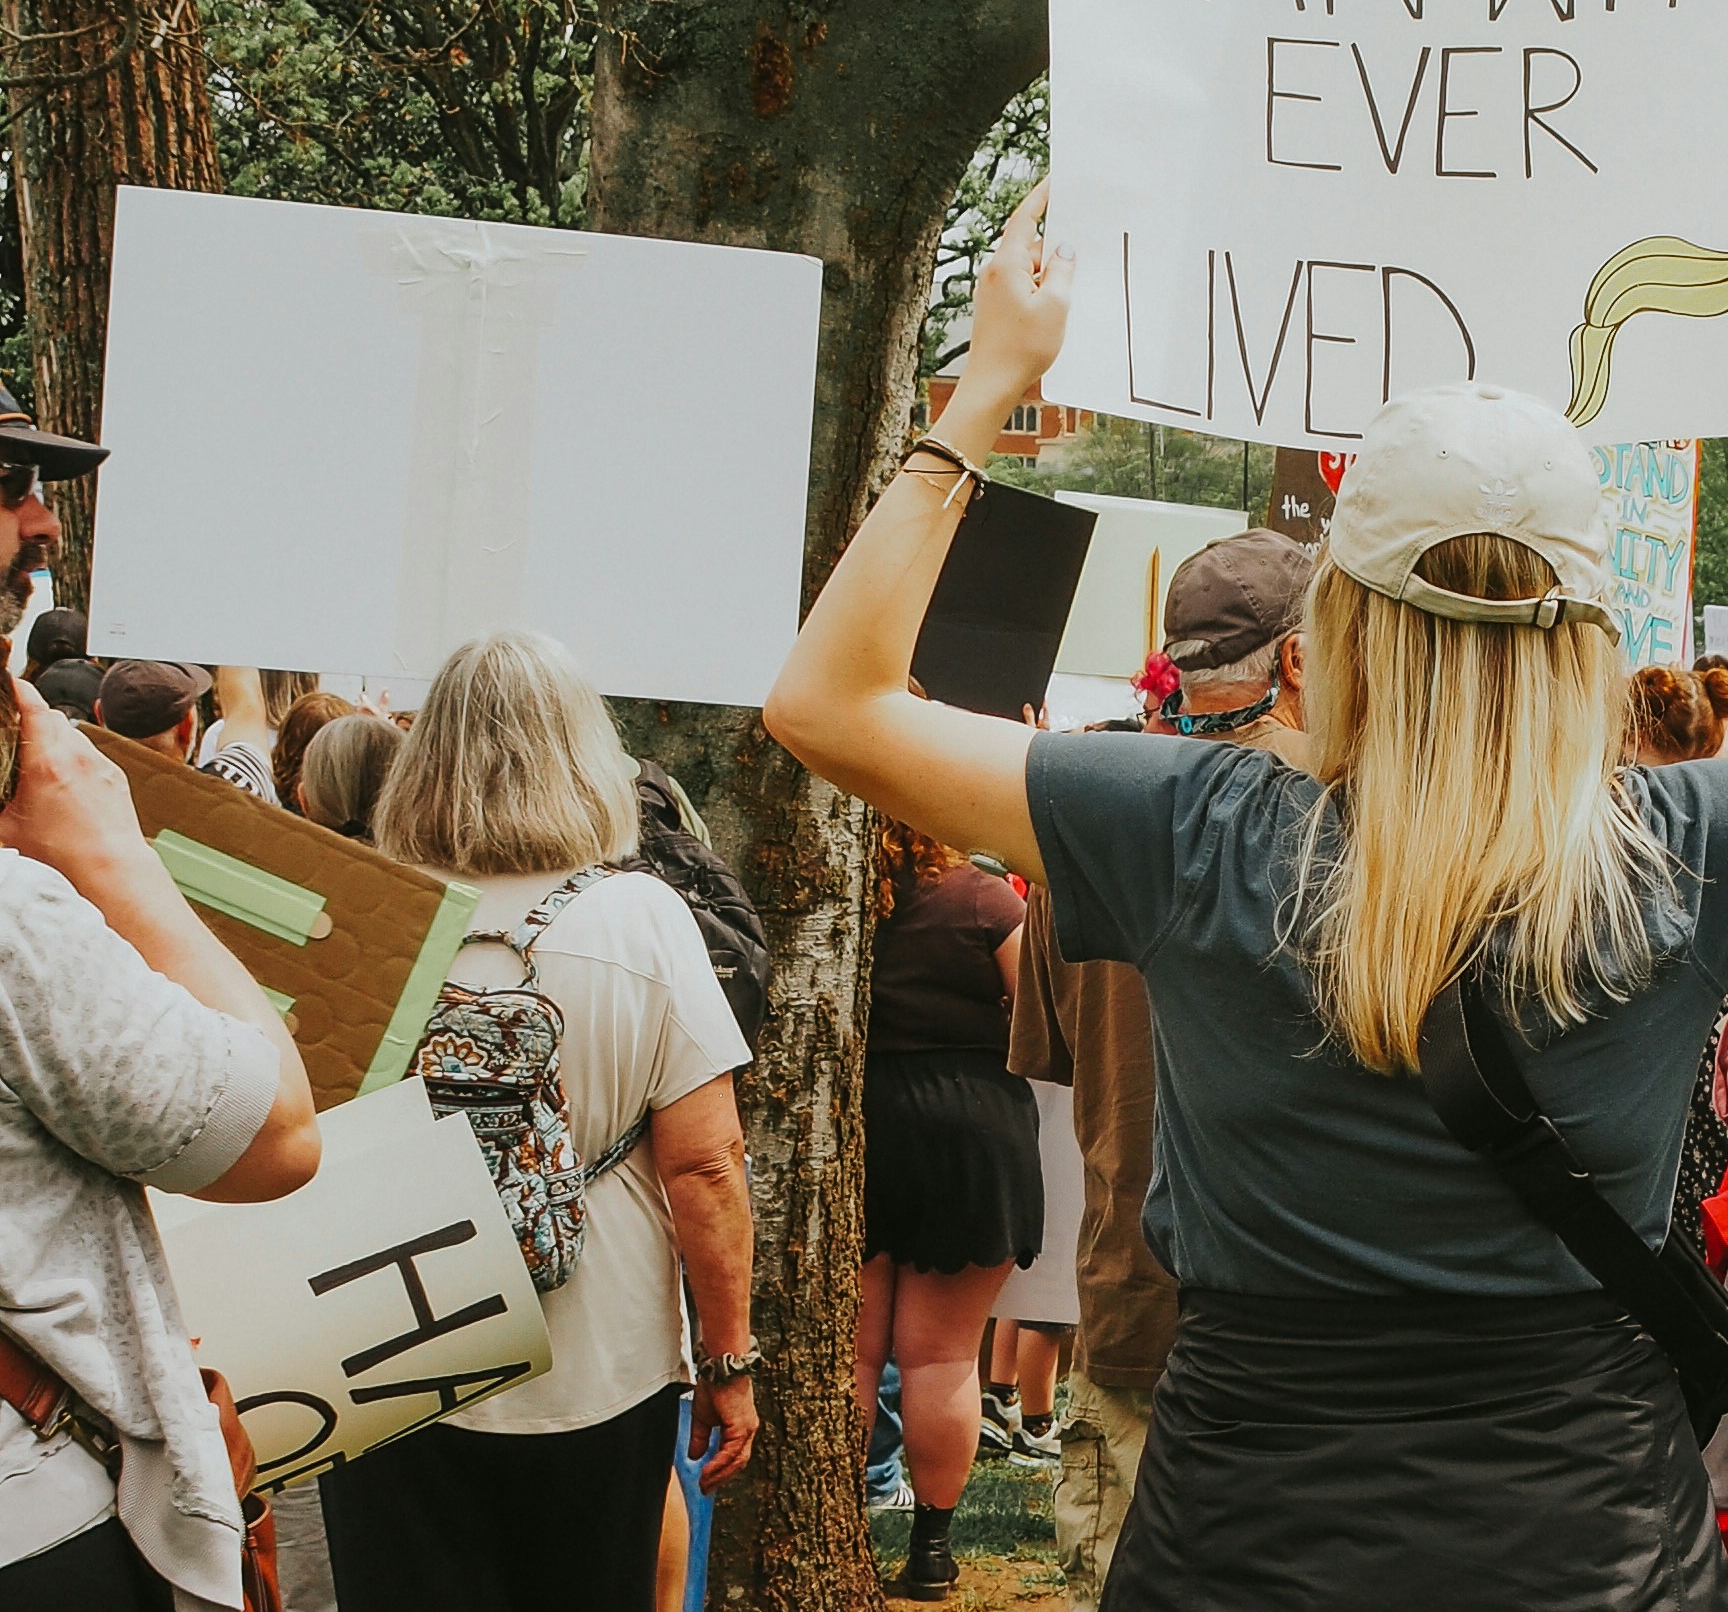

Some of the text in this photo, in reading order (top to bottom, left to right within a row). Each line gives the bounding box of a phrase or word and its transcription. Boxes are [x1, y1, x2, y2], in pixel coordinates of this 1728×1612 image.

[1266, 36, 1599, 181] EVER
[1123, 231, 1477, 439] LIVED
[1281, 494, 1312, 520] the
[1620, 495, 1648, 525] IN
